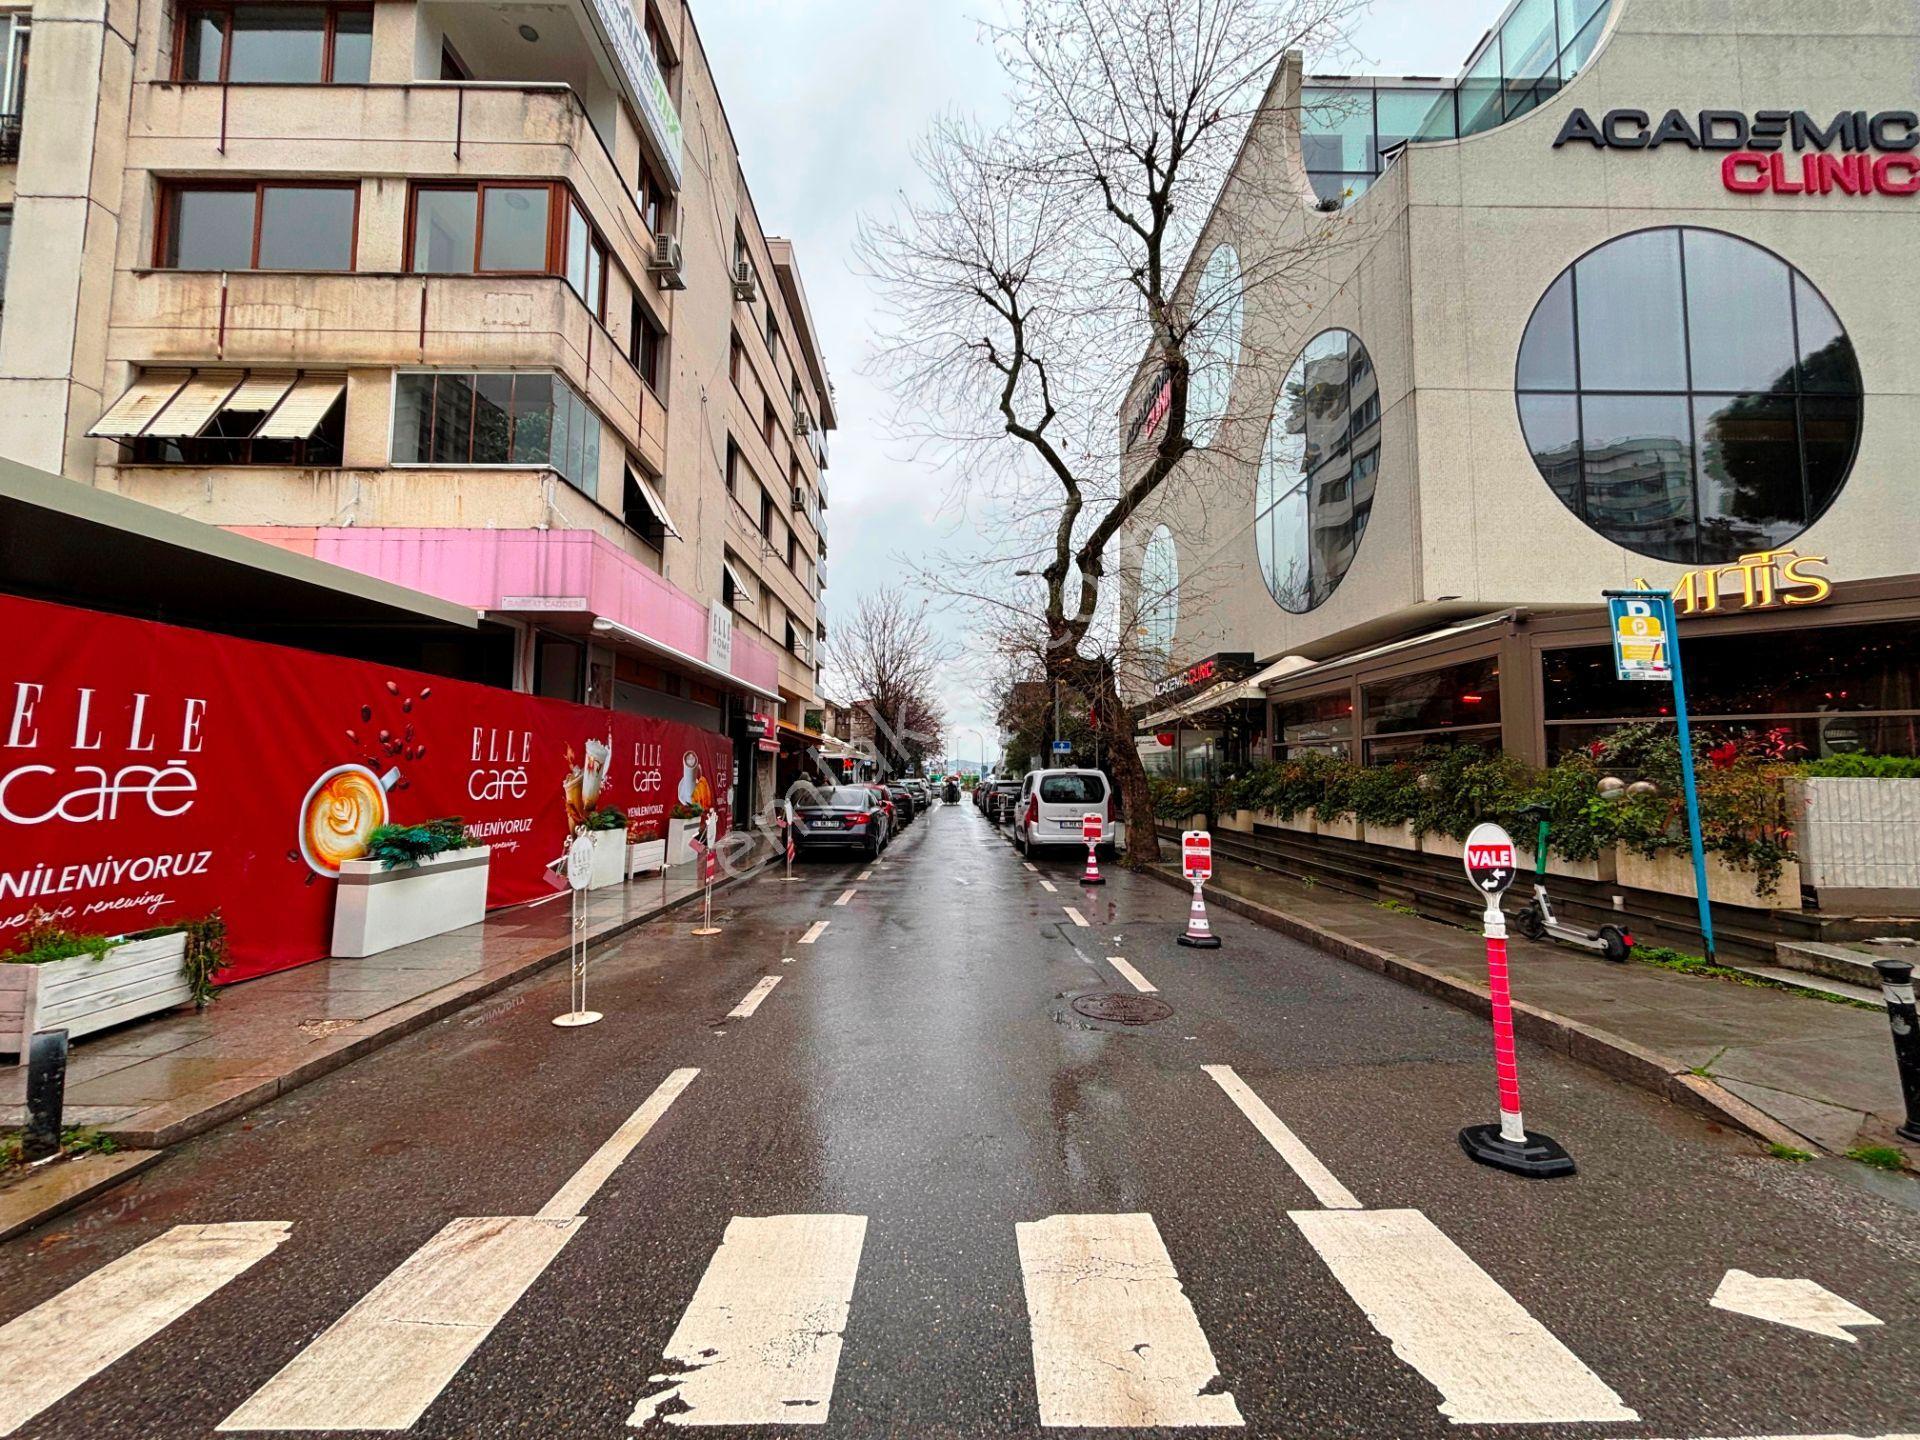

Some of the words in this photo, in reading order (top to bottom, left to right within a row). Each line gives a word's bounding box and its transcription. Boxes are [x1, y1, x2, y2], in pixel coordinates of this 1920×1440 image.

[1552, 107, 1919, 152] ACADEMIC
[1721, 152, 1920, 196] CLINIC
[713, 613, 731, 641] ELLE
[712, 634, 731, 653] HOME
[3, 682, 207, 752] ELLE
[470, 727, 533, 763] ELLE
[634, 742, 662, 767] ELLE
[1468, 850, 1511, 867] VALE
[82, 890, 176, 915] renewing
